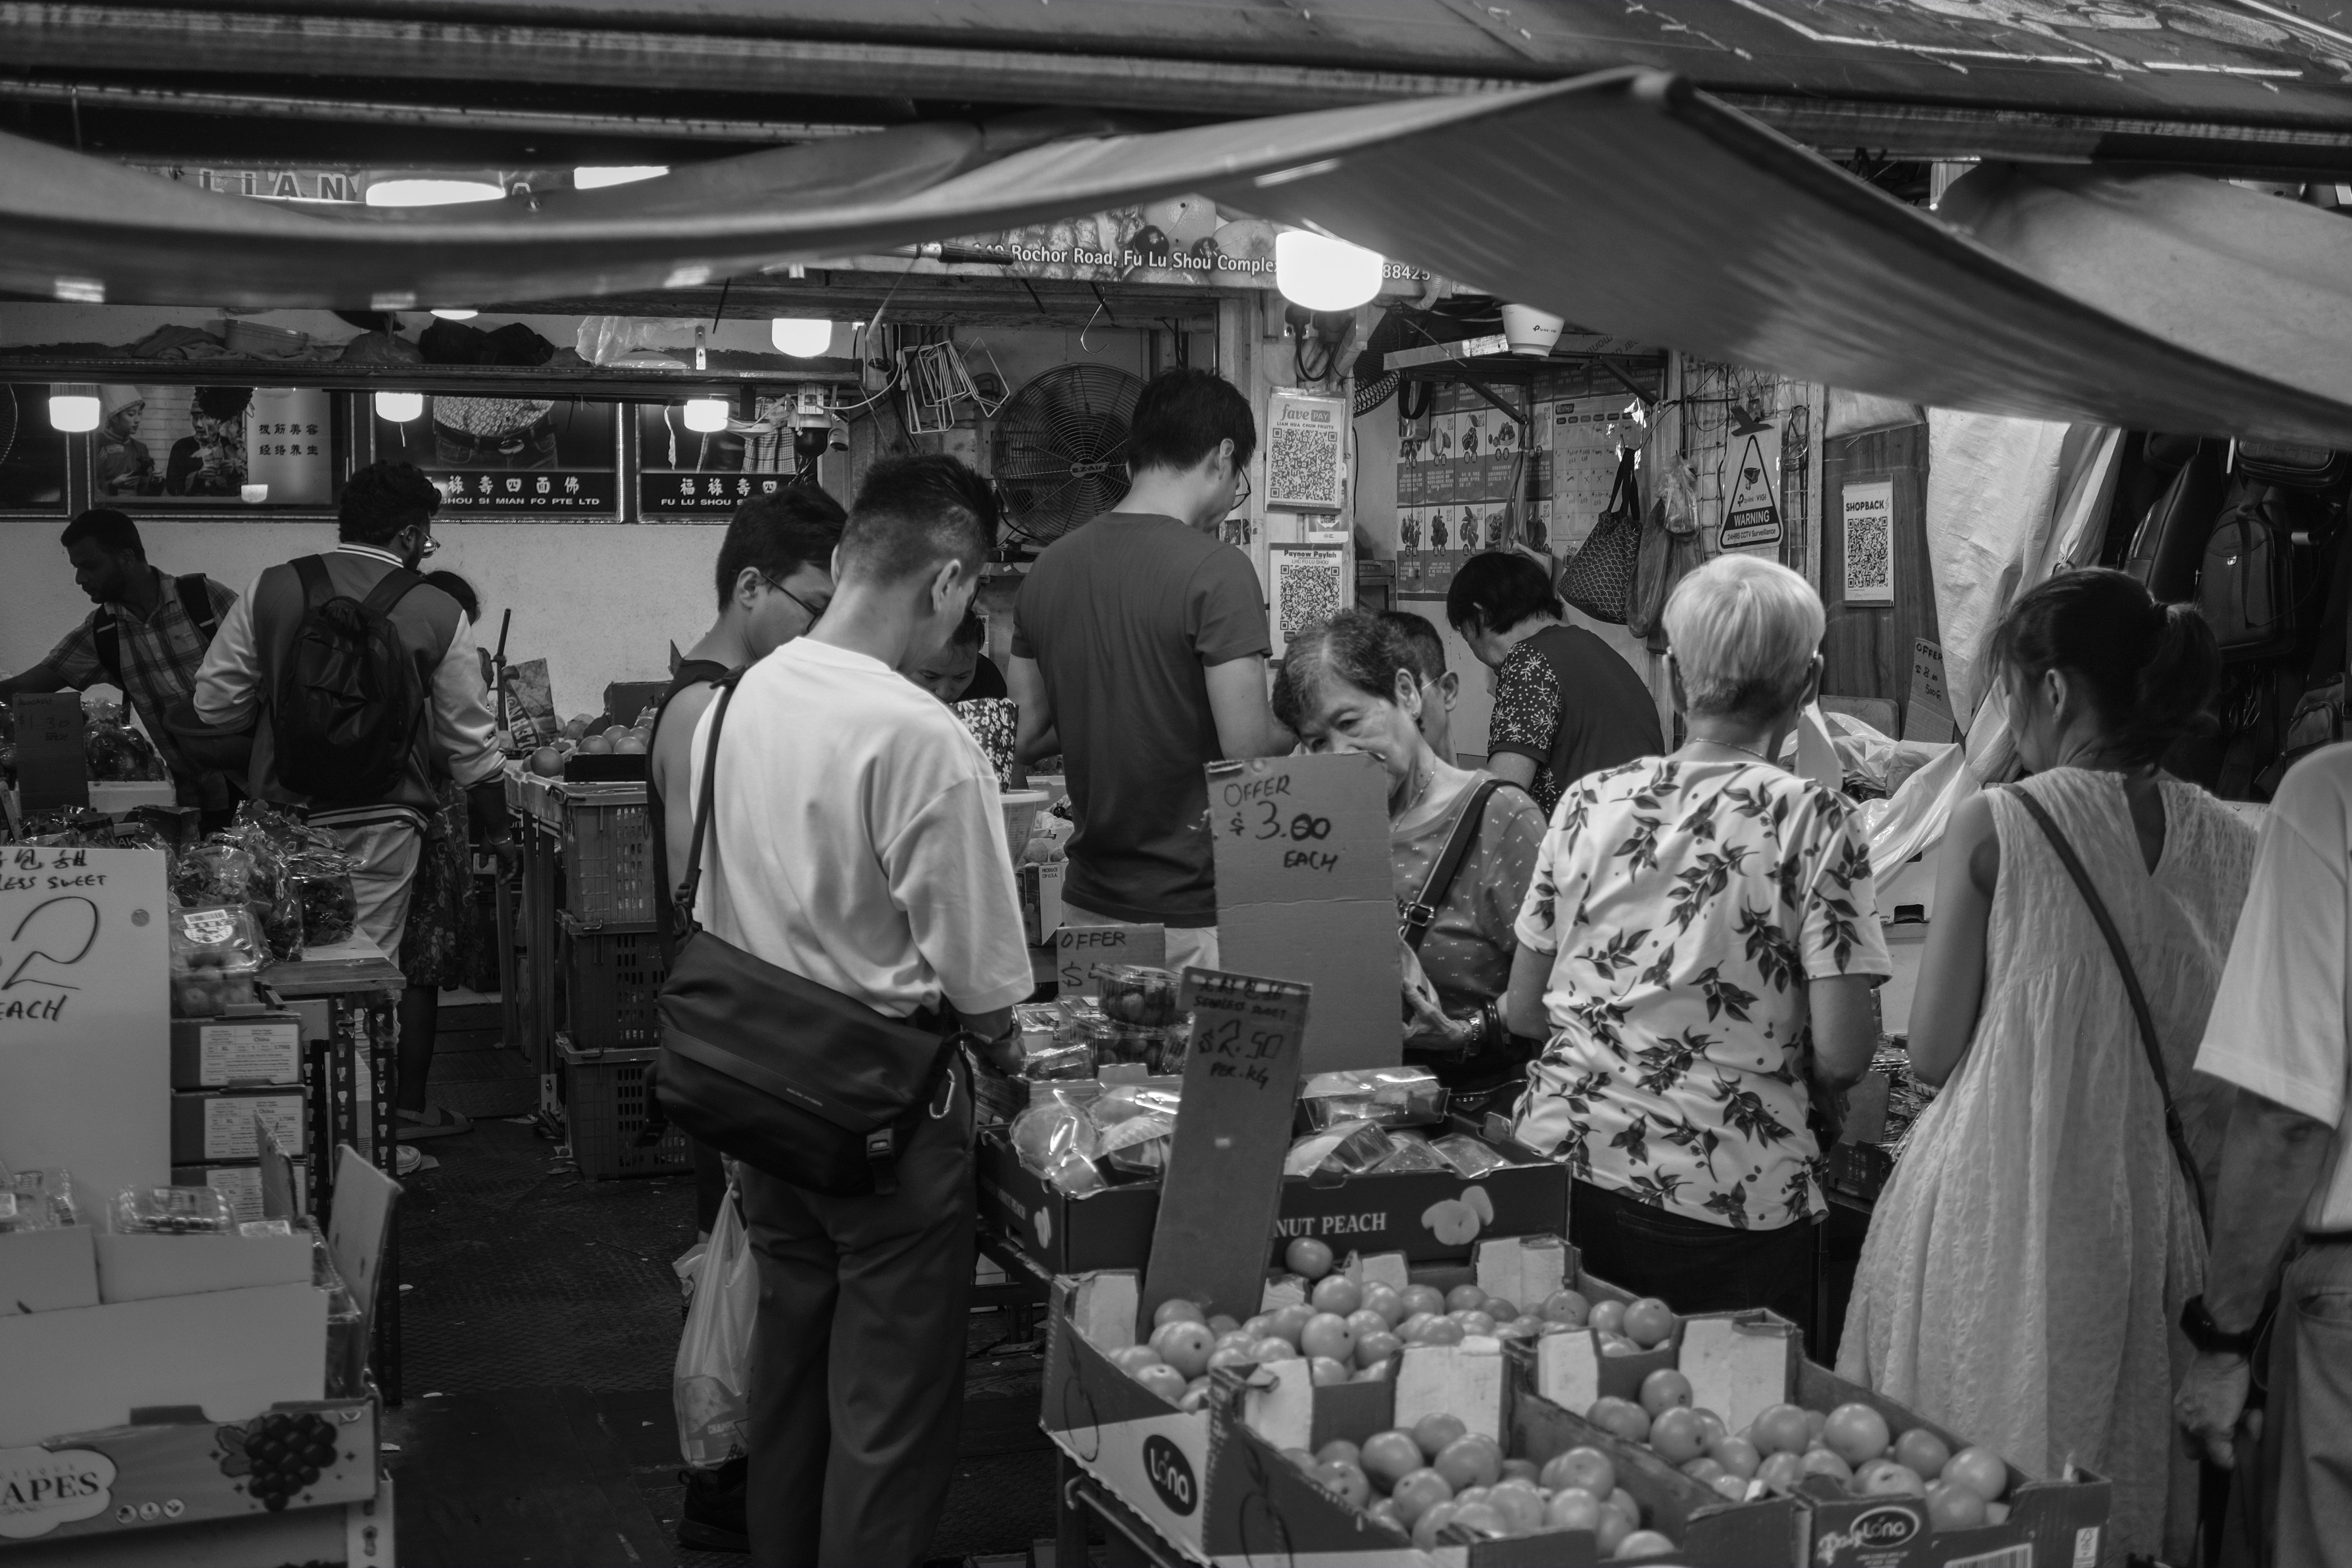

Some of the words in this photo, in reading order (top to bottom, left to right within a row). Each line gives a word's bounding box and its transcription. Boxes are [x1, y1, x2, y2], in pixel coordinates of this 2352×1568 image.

[198, 168, 348, 201] LIAN
[1012, 245, 1068, 263] Rochor
[1074, 248, 1118, 268] Road,
[1124, 250, 1142, 266] Fu
[1149, 251, 1167, 268] Lu
[1173, 252, 1211, 270] Shou
[1279, 404, 1310, 421] fave
[1313, 412, 1329, 420] PAY
[258, 443, 319, 456] 经络养生
[551, 497, 573, 505] PTE
[1756, 493, 1767, 502] VIGI
[1846, 500, 1885, 512] SHOPBACK
[1734, 510, 1770, 527] WARNING
[1727, 532, 1740, 540] 24HRS
[1740, 530, 1752, 539] CCTV
[1752, 528, 1776, 537] Surveillance
[1284, 550, 1312, 559] Paynow
[1916, 643, 1943, 664] OFFER
[18, 698, 52, 707] AVOCADO
[45, 732, 68, 741] EACH
[1224, 773, 1292, 808] OFFER
[1283, 848, 1338, 873] EACH
[47, 875, 110, 889] SWEET
[1060, 931, 1127, 951] OFFER
[1274, 1217, 1315, 1237] NUT
[1321, 1212, 1387, 1235] PEACH
[1, 1471, 99, 1506] APES
